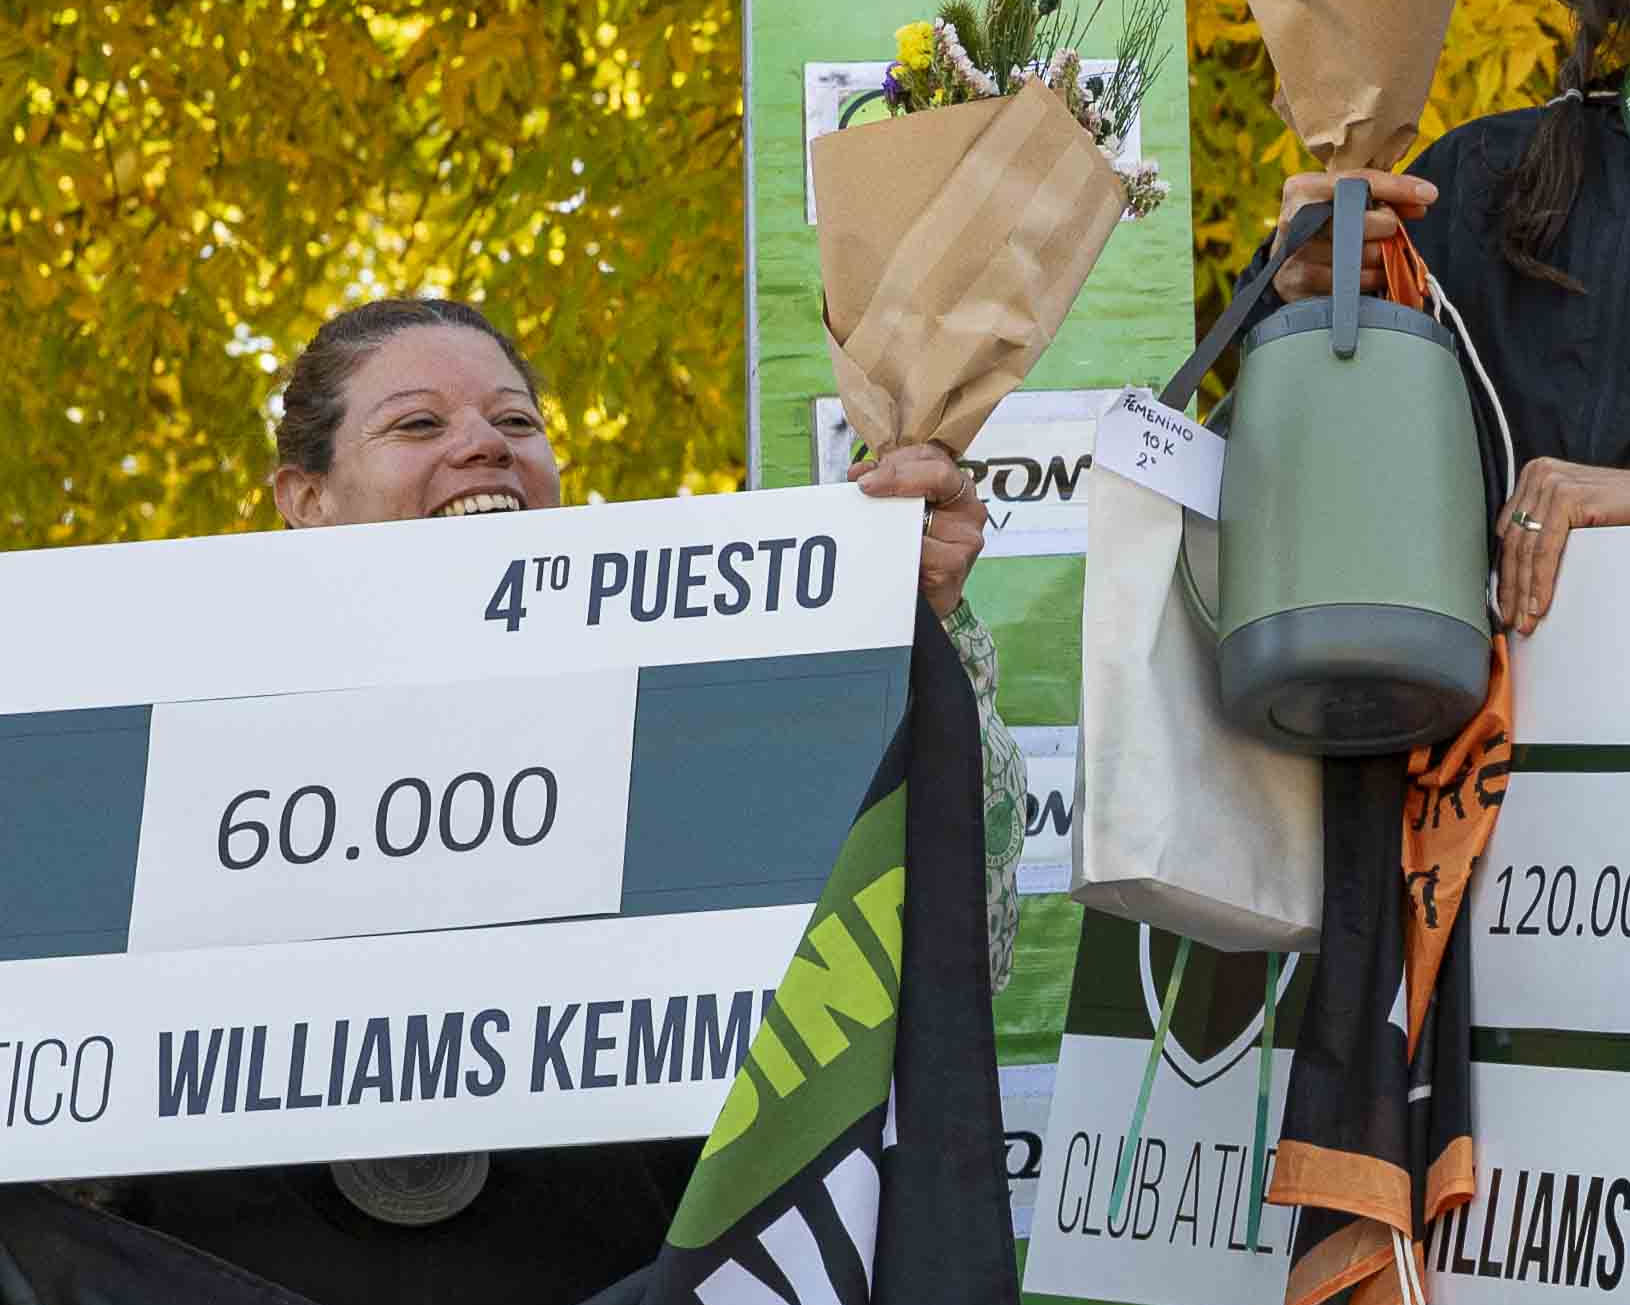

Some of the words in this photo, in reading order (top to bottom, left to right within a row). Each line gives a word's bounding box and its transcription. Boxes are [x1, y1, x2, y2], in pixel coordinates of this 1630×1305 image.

[586, 534, 838, 627] PUESTO
[217, 765, 559, 871] 60.000
[0, 1034, 114, 1130] ICO
[157, 1007, 510, 1119] WILLIAMS
[530, 988, 774, 1095] KEMM
[1058, 1131, 1166, 1240] CLUB
